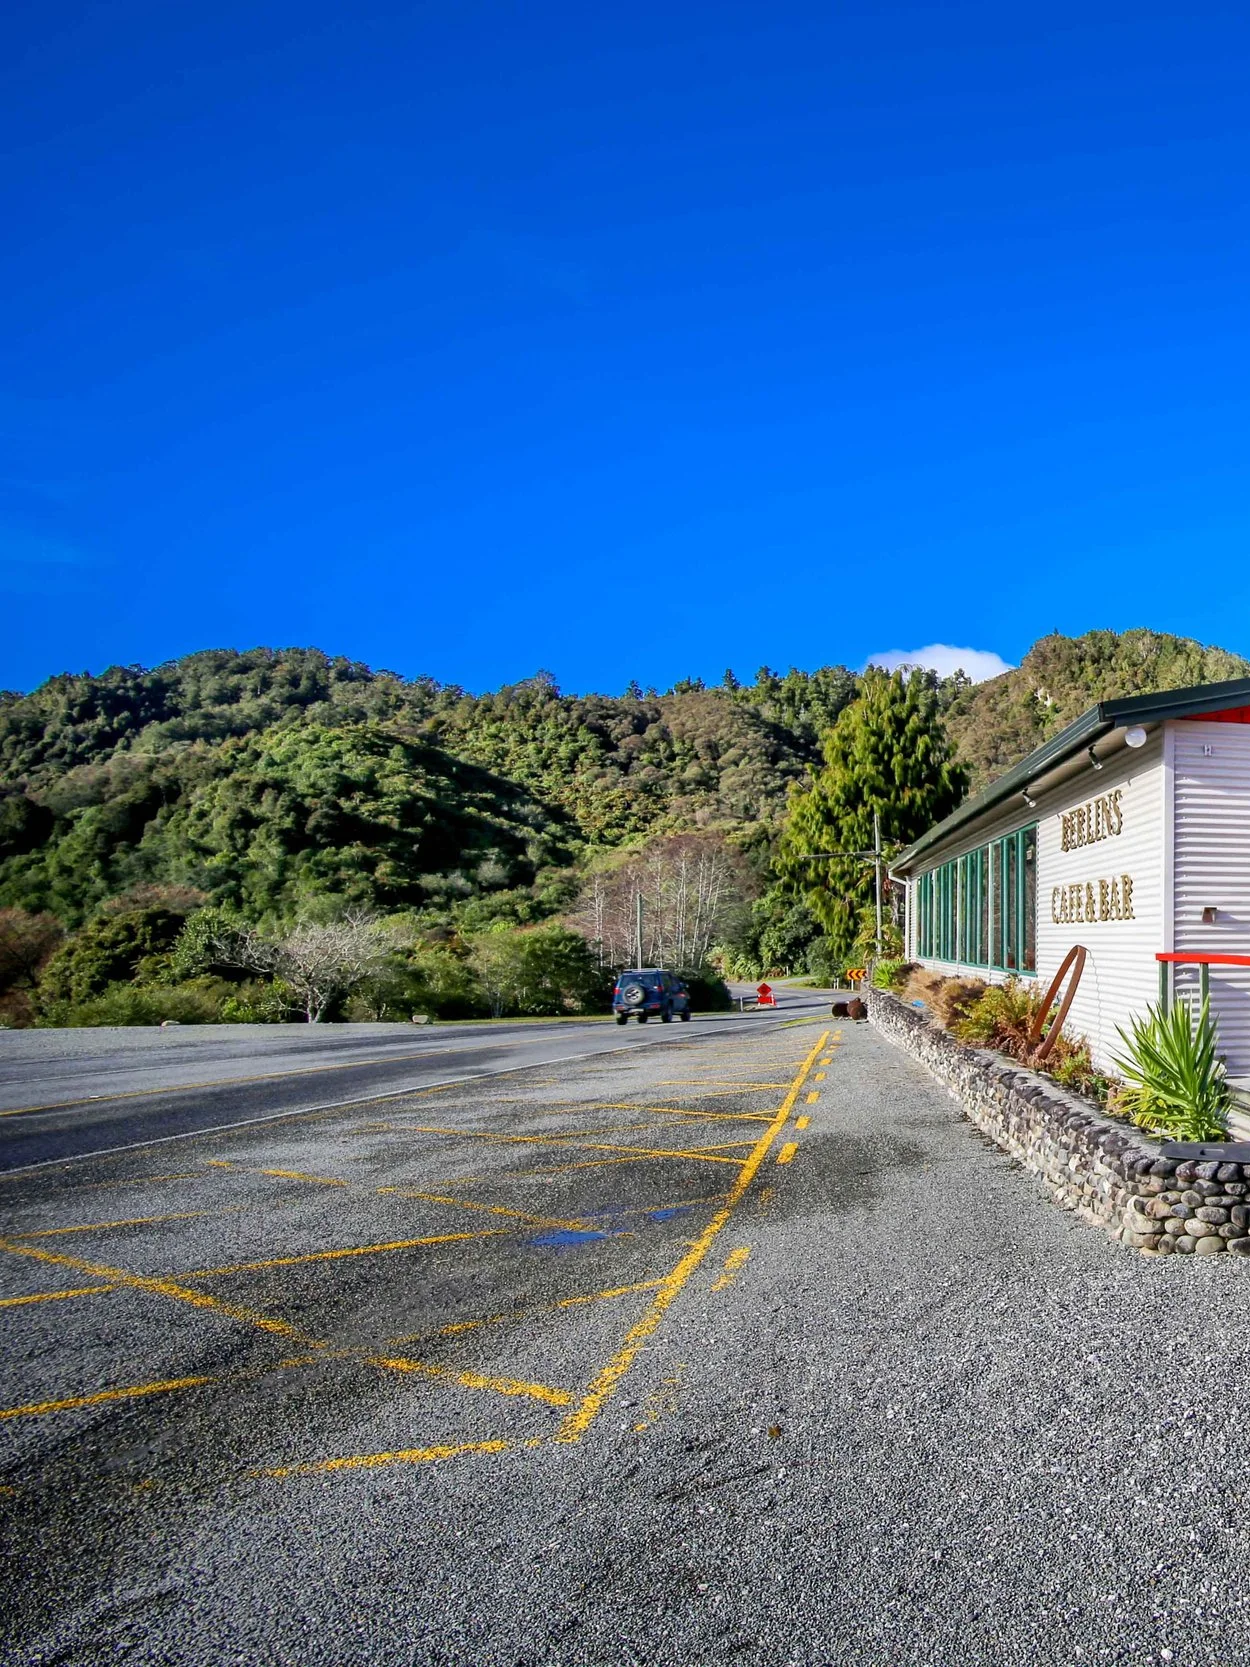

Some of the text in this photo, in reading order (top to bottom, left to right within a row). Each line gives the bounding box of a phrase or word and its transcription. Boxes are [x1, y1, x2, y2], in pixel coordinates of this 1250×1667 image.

[1061, 789, 1123, 852] BERLINS
[1052, 873, 1136, 924] CAFE & BAR
